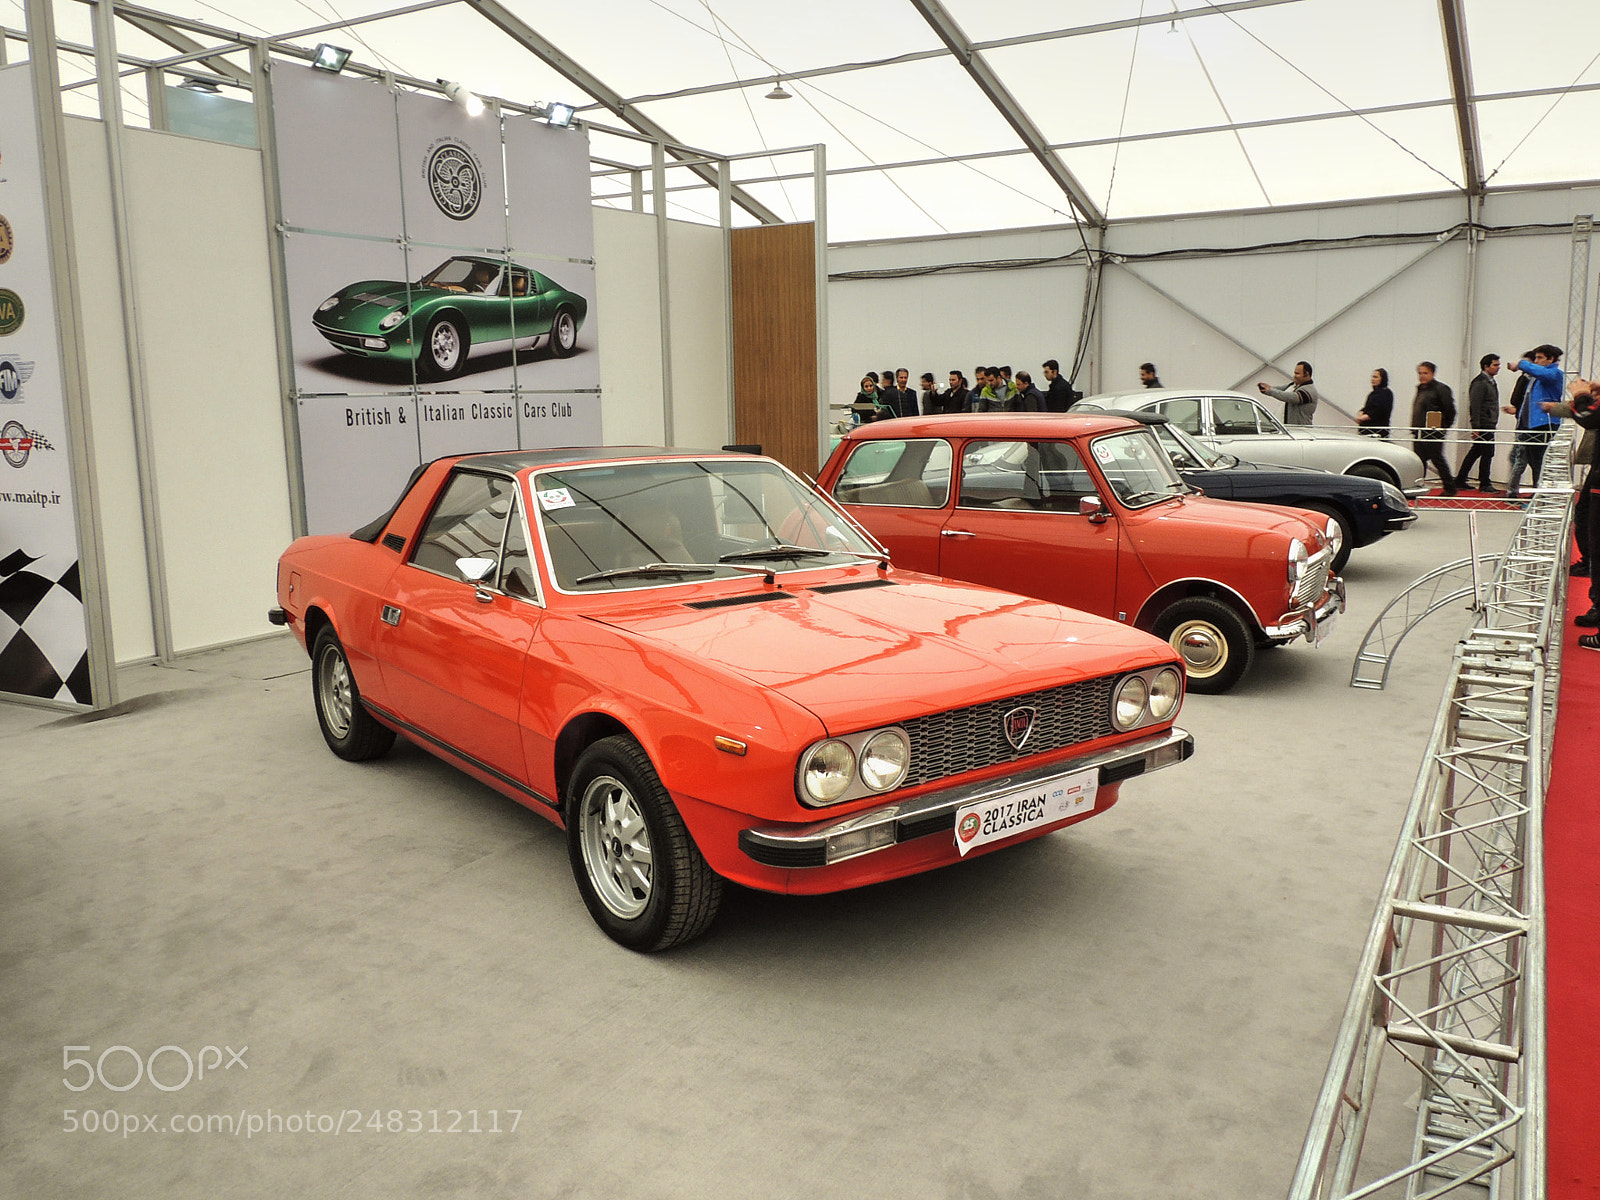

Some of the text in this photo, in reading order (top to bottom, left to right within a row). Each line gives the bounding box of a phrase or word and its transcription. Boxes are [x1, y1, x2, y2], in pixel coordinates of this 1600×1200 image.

[440, 150, 468, 163] CLASSIC
[345, 402, 572, 427] British & Italian Classic Cars Club
[0, 490, 60, 508] w.maitp.ir
[983, 803, 1014, 823] 2017
[1017, 793, 1046, 813] IRAN
[983, 808, 1044, 836] CLASSICA
